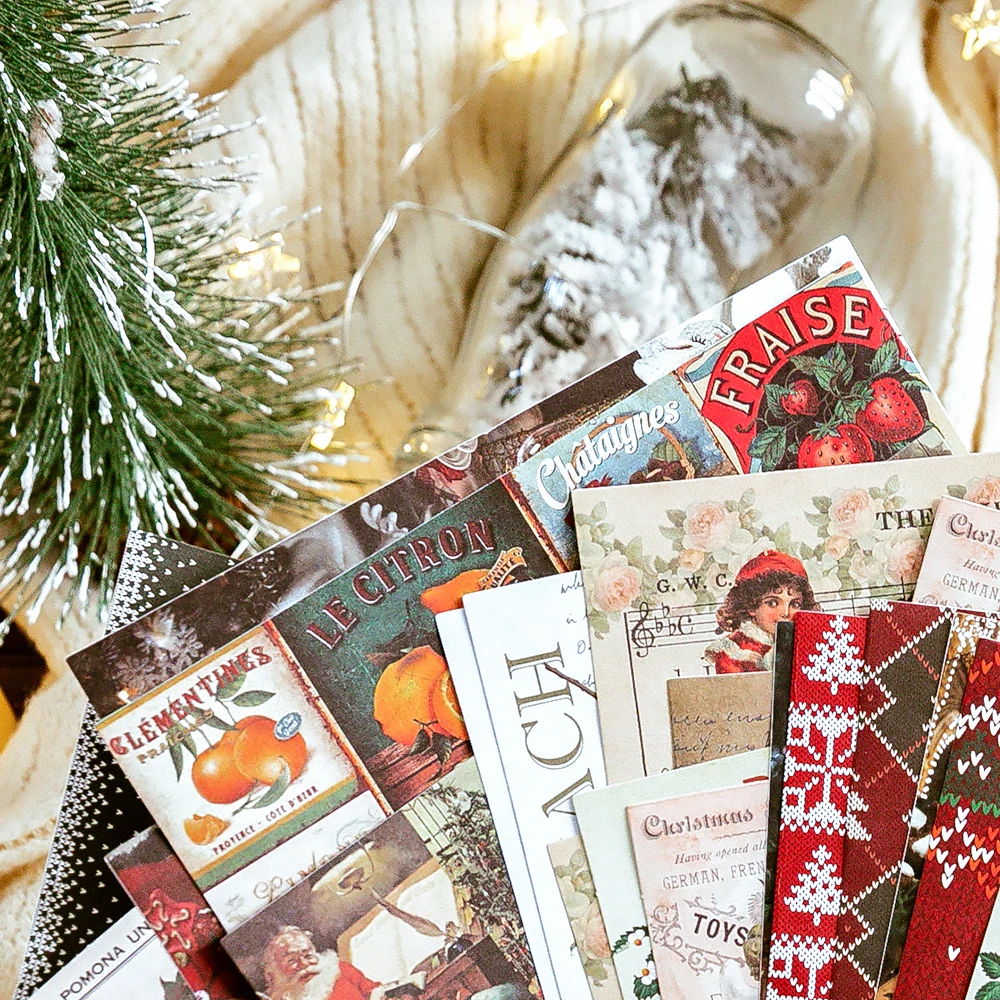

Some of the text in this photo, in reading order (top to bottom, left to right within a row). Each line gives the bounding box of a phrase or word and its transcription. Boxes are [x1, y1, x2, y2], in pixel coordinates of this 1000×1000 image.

[710, 293, 873, 414] FRAISE
[536, 399, 681, 510] Châtaignes
[876, 508, 933, 531] THE
[305, 515, 500, 652] LE CITRON
[656, 573, 678, 594] G.
[684, 572, 707, 591] W.
[963, 558, 1000, 580] Having
[108, 642, 274, 758] CLÉMENTINES
[643, 807, 753, 840] Christmas
[212, 826, 255, 855] PROVENCE
[674, 852, 712, 865] Having
[715, 843, 748, 860] opened
[662, 867, 724, 890] GERMAN,
[693, 912, 748, 947] TOYS
